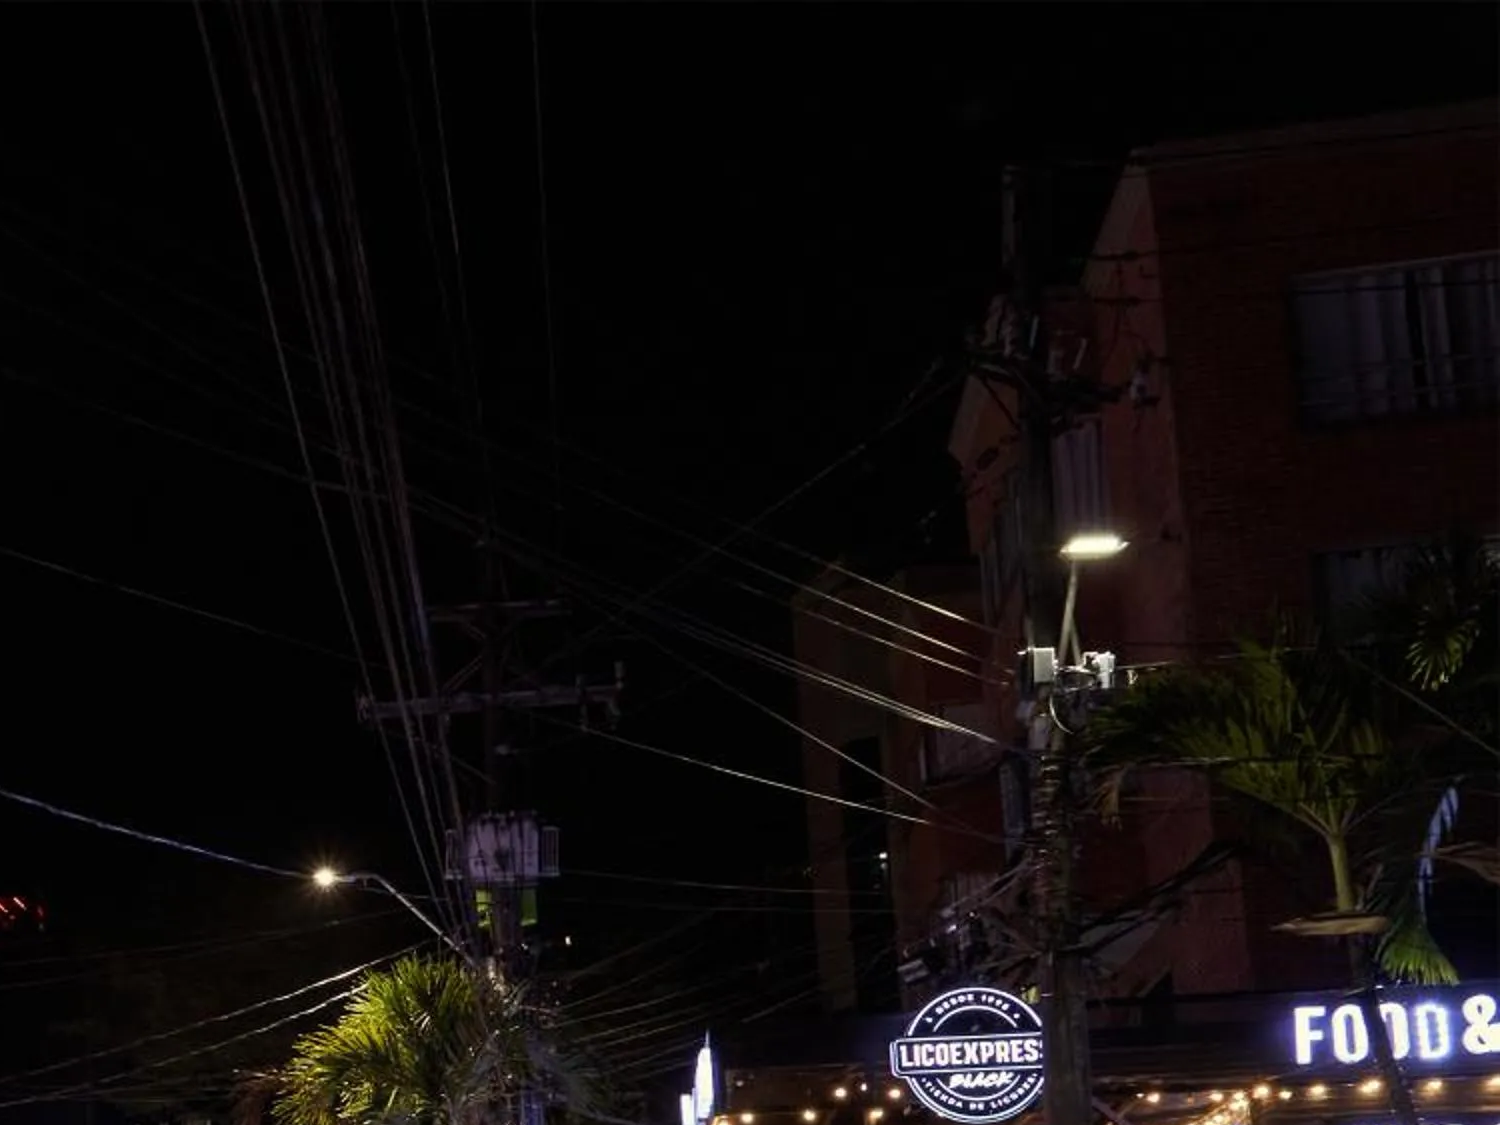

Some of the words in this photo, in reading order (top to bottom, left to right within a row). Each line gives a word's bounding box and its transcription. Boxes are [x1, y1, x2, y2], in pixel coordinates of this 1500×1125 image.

[1462, 994, 1500, 1054] &
[899, 1038, 1043, 1068] LICOEXPRES
[925, 1080, 963, 1109] TIENDA
[969, 1102, 985, 1110] DE
